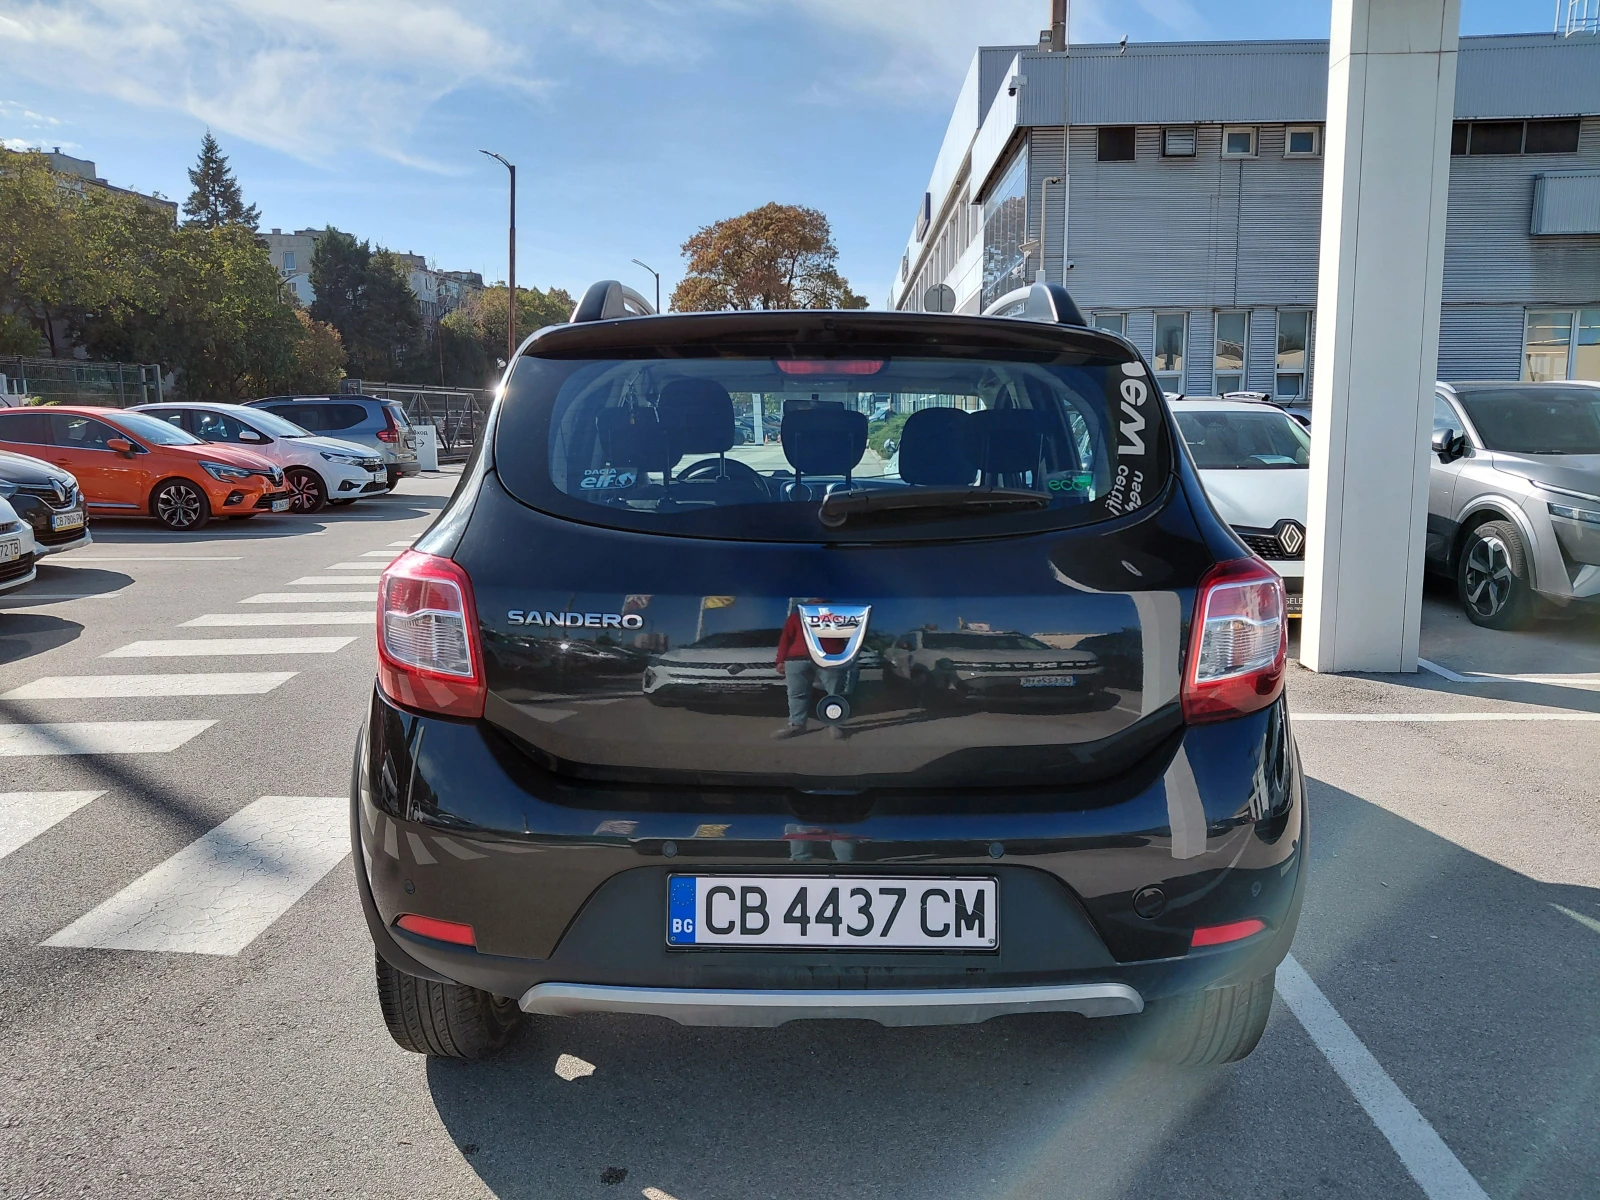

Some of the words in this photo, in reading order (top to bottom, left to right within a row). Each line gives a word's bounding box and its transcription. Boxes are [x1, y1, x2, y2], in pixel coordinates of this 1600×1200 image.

[580, 475, 617, 488] elf
[56, 516, 63, 527] CB
[10, 542, 19, 556] TB
[507, 610, 643, 629] SANDERO
[810, 615, 858, 624] DACIA
[705, 885, 770, 936] CB
[783, 886, 907, 938] 4437
[920, 888, 985, 938] CM
[672, 918, 693, 933] BG
